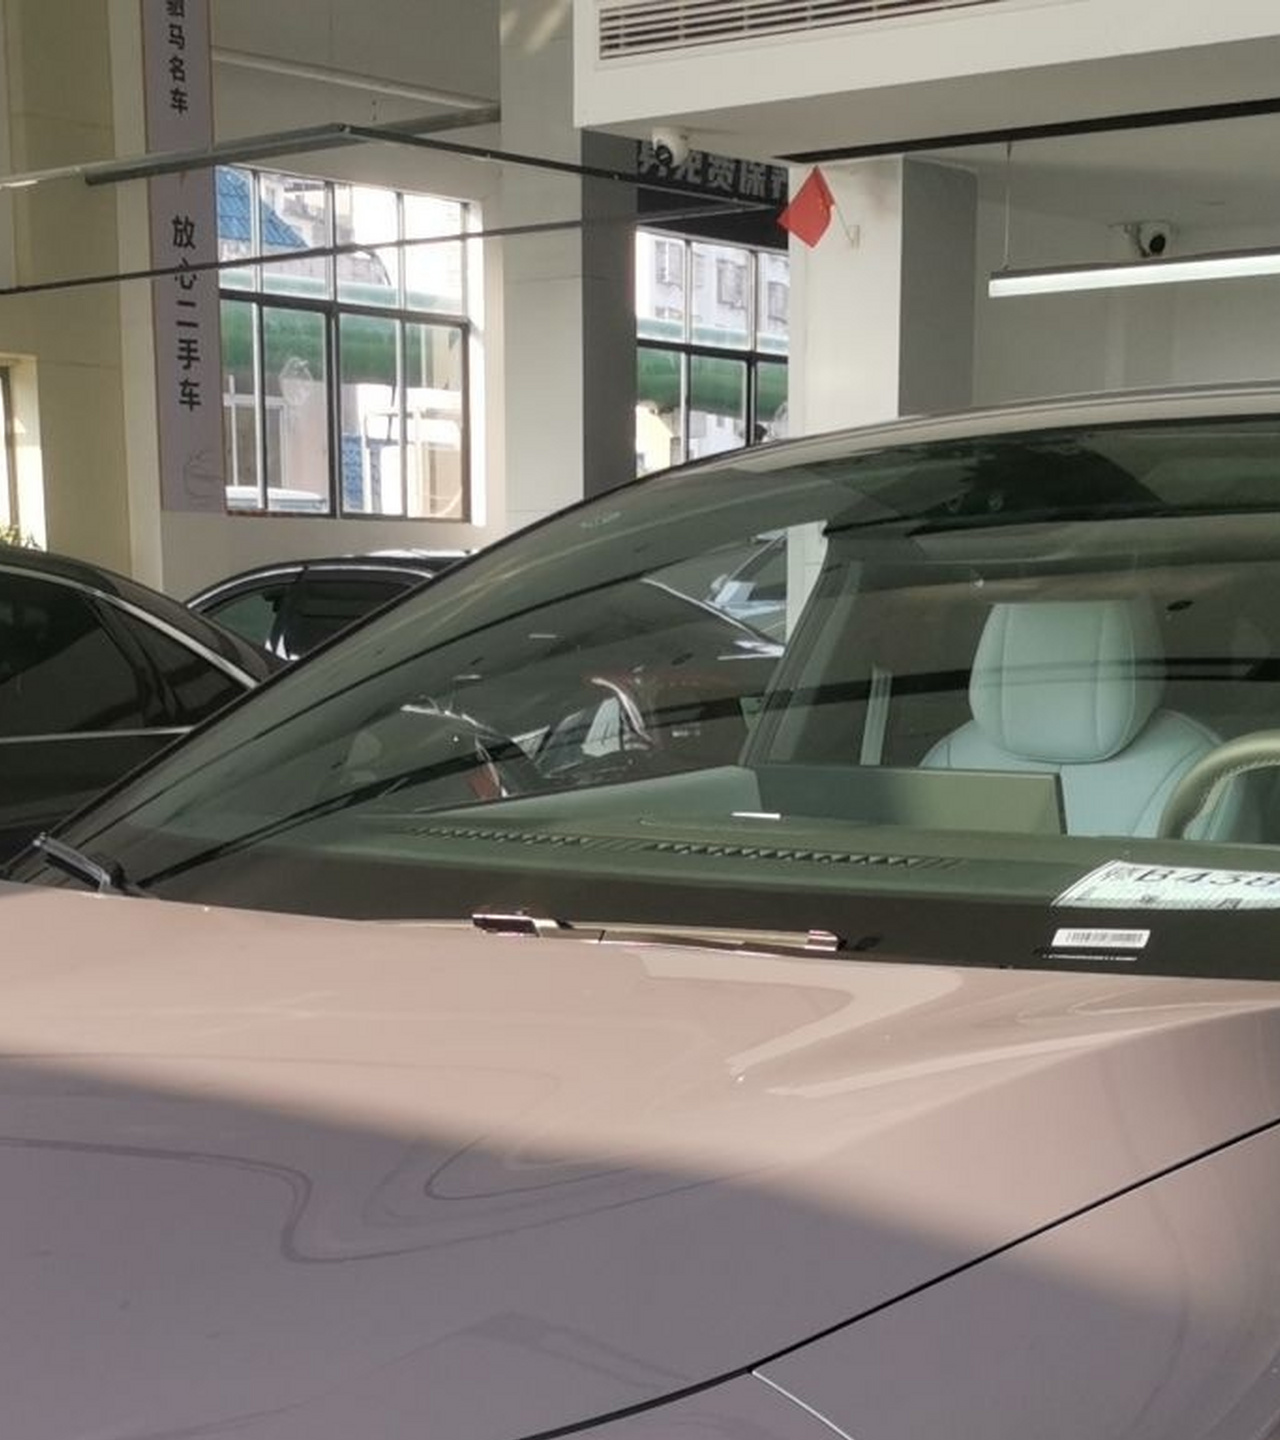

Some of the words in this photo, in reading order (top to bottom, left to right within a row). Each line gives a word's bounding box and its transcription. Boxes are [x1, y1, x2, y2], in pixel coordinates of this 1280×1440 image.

[172, 215, 202, 412] 放心二手车
